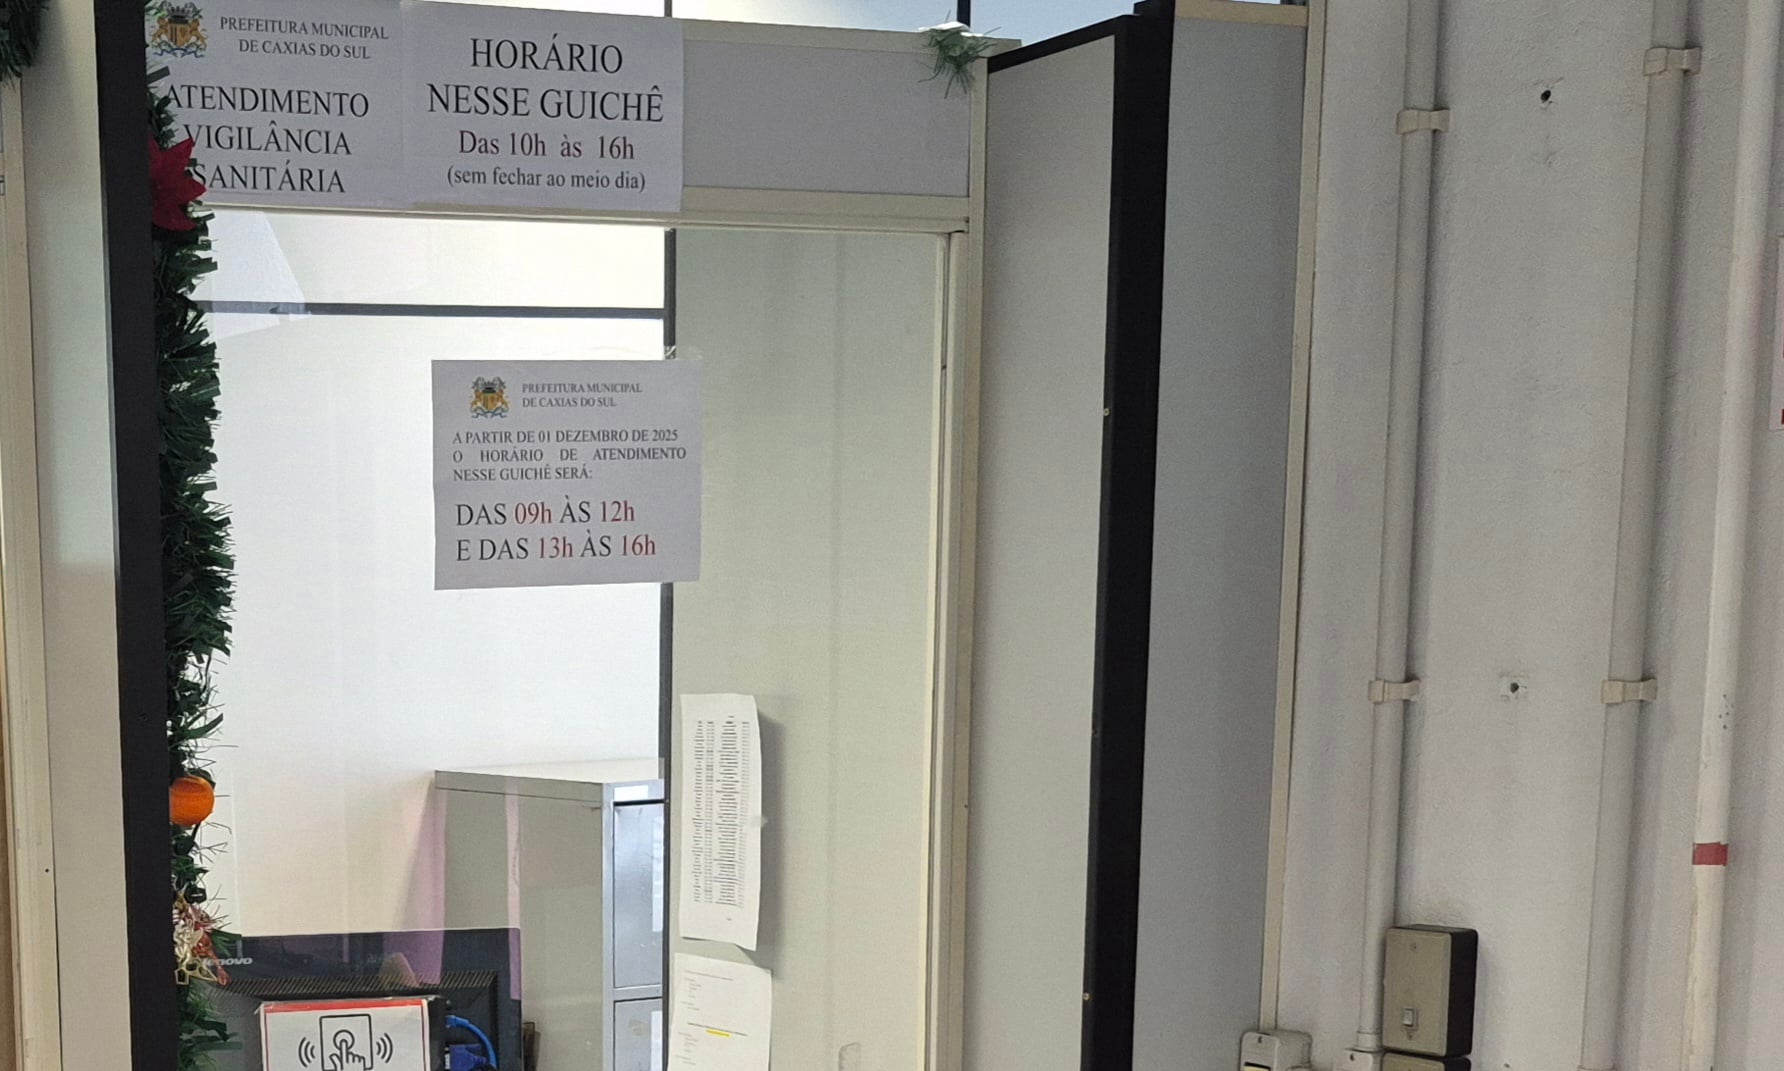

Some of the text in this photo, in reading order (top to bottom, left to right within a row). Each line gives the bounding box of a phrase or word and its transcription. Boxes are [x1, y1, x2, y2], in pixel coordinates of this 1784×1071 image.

[220, 17, 389, 40] PREFEITURA MUNICIPAL
[239, 39, 371, 60] DE CAXIAS DO SUL
[471, 33, 623, 74] HORÁRIO
[165, 84, 369, 118] ATENDIMENTO
[427, 83, 663, 123] NESSE GUICHÊ
[183, 120, 351, 156] VIGILÂNCIA
[459, 129, 634, 160] Das 10h às 16h
[447, 166, 646, 193] (sem fechar ao meio dia)
[522, 383, 643, 394] PREFEITURA MUNICIPAL
[522, 397, 617, 408] DE CAXIAS DO SUL
[452, 428, 679, 445] A PARTIR DE 01 DEZEMBRO DE 2025
[452, 446, 687, 463] O HORÁRIO DE ATENDIMENTO
[453, 463, 593, 482] NESSE GUICHÊ SERÁ:
[456, 494, 635, 526] DAS 09h ÀS 12h
[457, 529, 656, 562] E DAS 13h ÀS 16h
